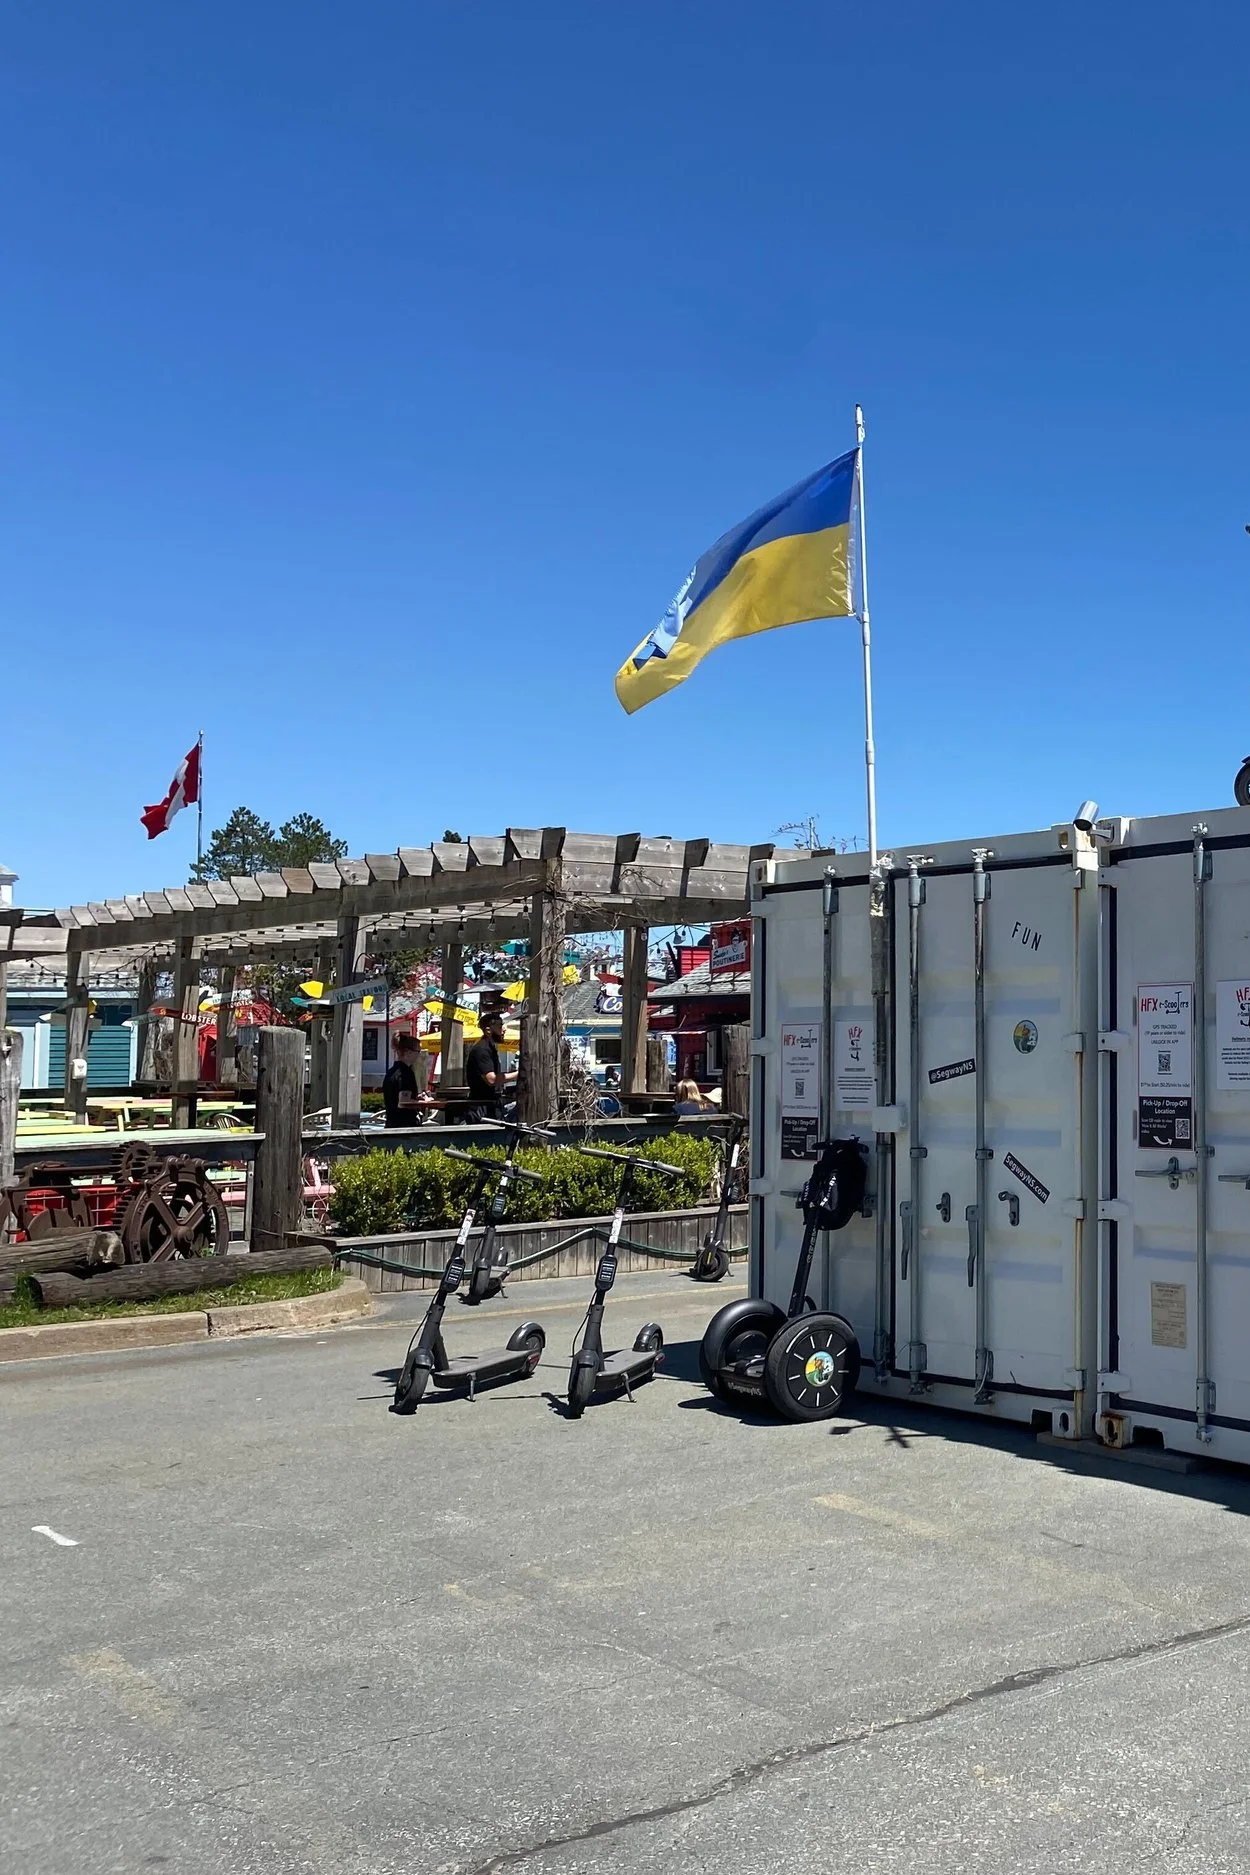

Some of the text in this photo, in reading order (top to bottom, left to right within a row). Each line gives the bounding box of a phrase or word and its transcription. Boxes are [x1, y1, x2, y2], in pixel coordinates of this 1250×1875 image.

[1011, 921, 1042, 951] FUN
[435, 990, 475, 1010] COLD BEER
[603, 997, 622, 1011] Co
[1141, 998, 1158, 1012] HFX
[181, 1013, 217, 1025] LOBSTER
[849, 1026, 863, 1039] HFX
[783, 1034, 797, 1046] HFX
[930, 1061, 974, 1081] @SegwayNS
[1005, 1155, 1049, 1201] SegwayNS.com
